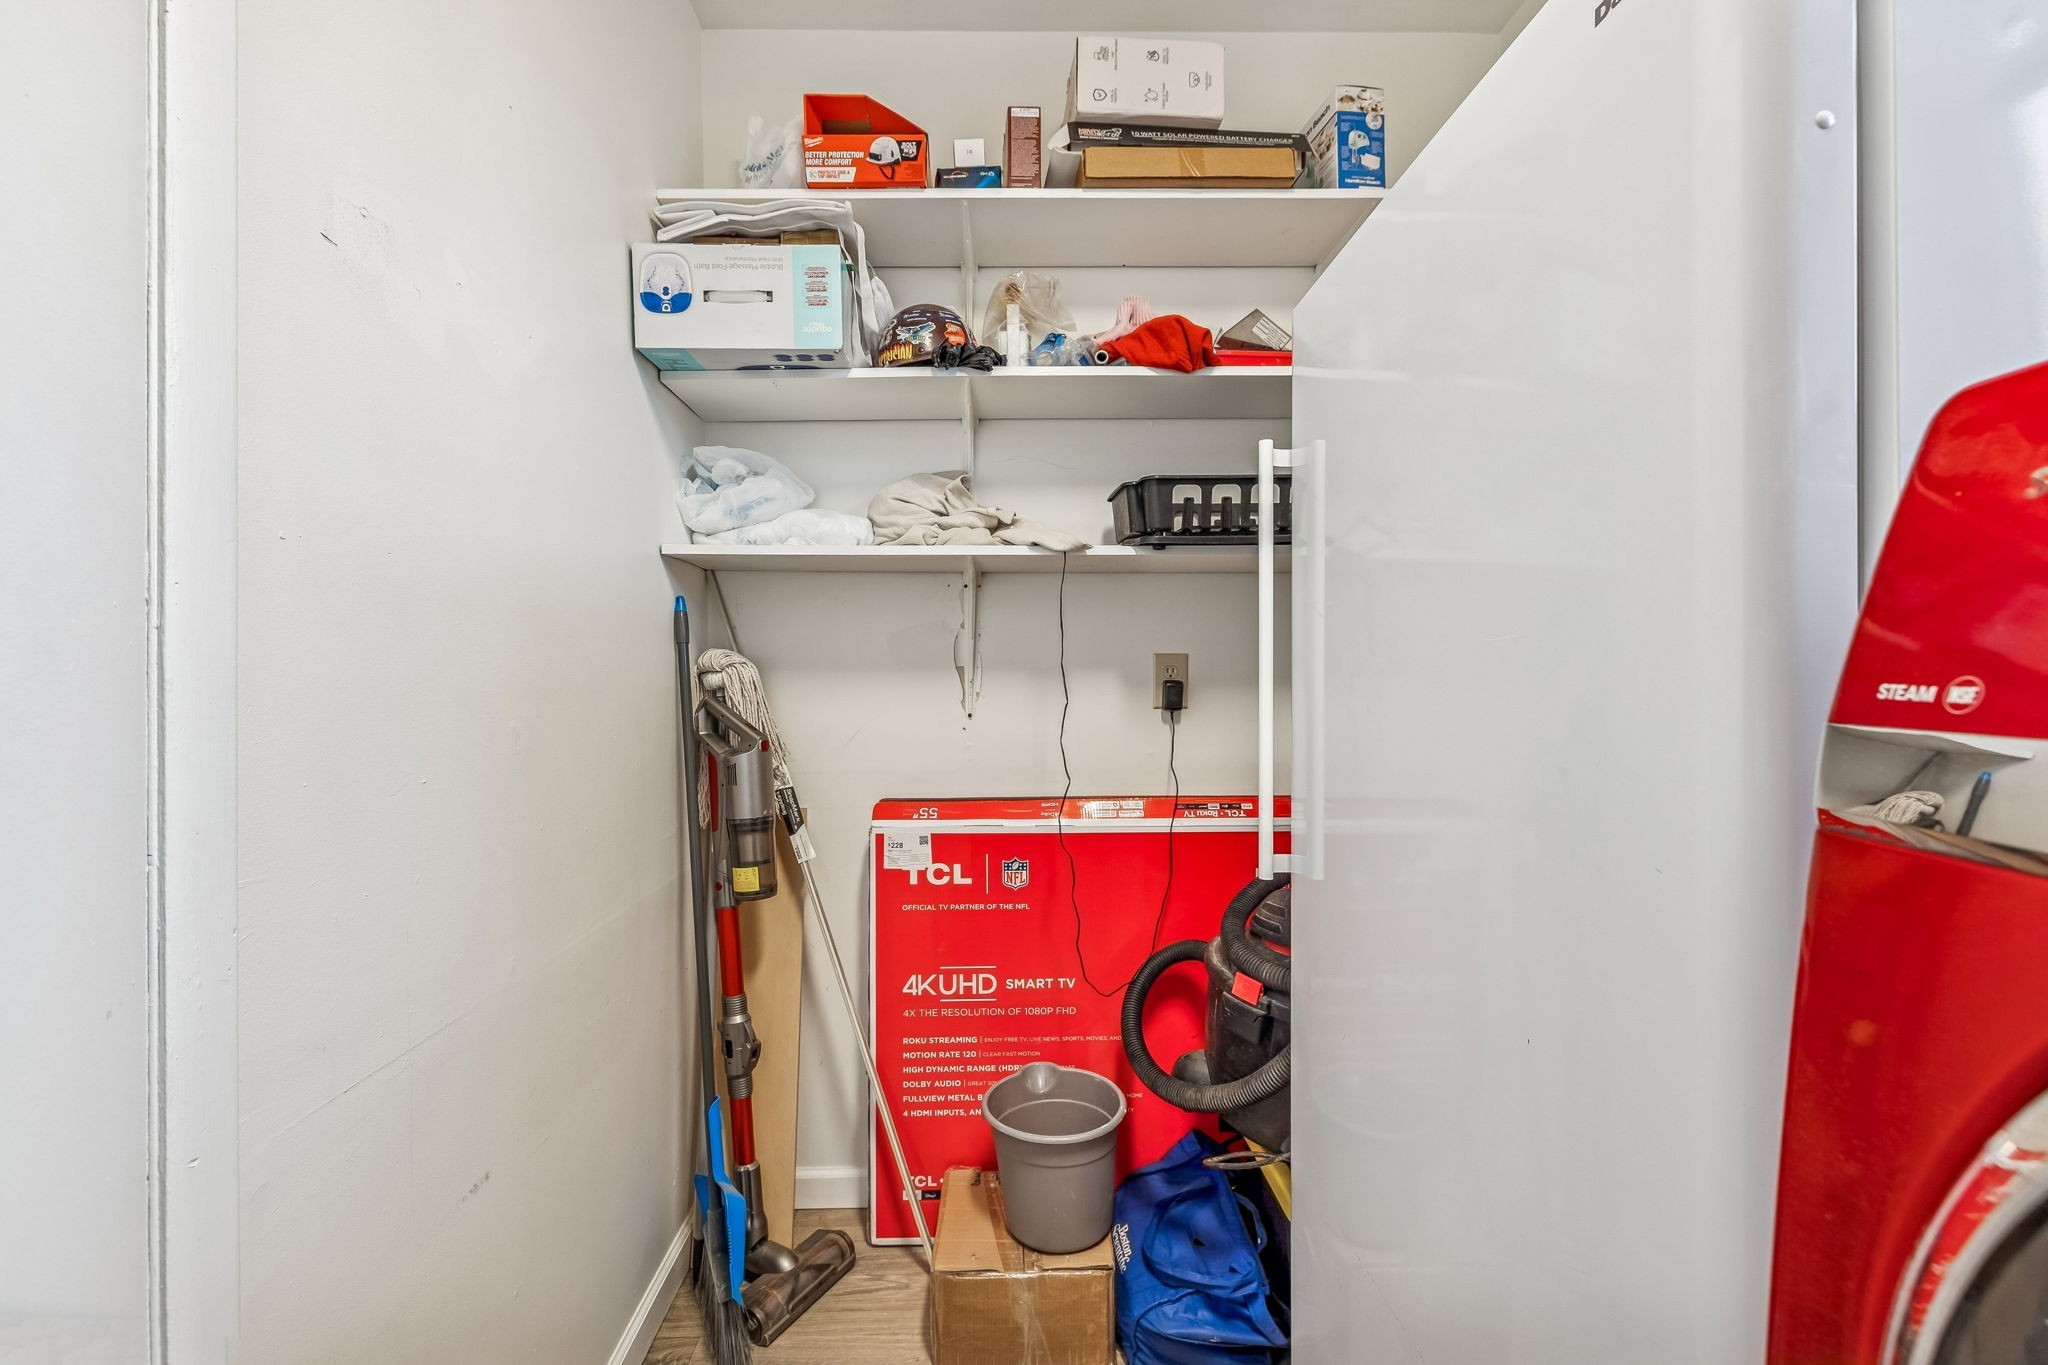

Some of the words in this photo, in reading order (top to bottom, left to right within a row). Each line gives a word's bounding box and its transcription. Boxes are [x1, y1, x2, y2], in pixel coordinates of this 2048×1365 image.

[824, 158, 853, 166] COMFORT
[693, 263, 710, 271] Bath
[711, 263, 728, 271] Foot
[729, 262, 758, 271] Massage
[760, 263, 783, 271] Bubble
[1876, 683, 1939, 704] STEAM
[1184, 809, 1196, 818] TV
[1196, 809, 1219, 817] Roku
[1224, 809, 1247, 817] TCL
[902, 862, 973, 886] TCL
[1005, 871, 1026, 886] NFL
[1005, 978, 1053, 989] SMART
[1058, 978, 1076, 988] TV
[903, 1009, 916, 1017] 4X
[919, 1009, 938, 1017] THE
[941, 1008, 1005, 1017] RESOLUTION
[1008, 1007, 1021, 1016] OF
[1025, 1007, 1053, 1016] 1080P
[1056, 1006, 1077, 1015] FHD
[903, 1037, 927, 1045] ROKU
[929, 1036, 978, 1044] STREAMING
[947, 1094, 975, 1102] METAL
[934, 1109, 967, 1117] INPUTS,
[910, 1175, 938, 1187] CL
[1118, 1223, 1132, 1258] Boston
